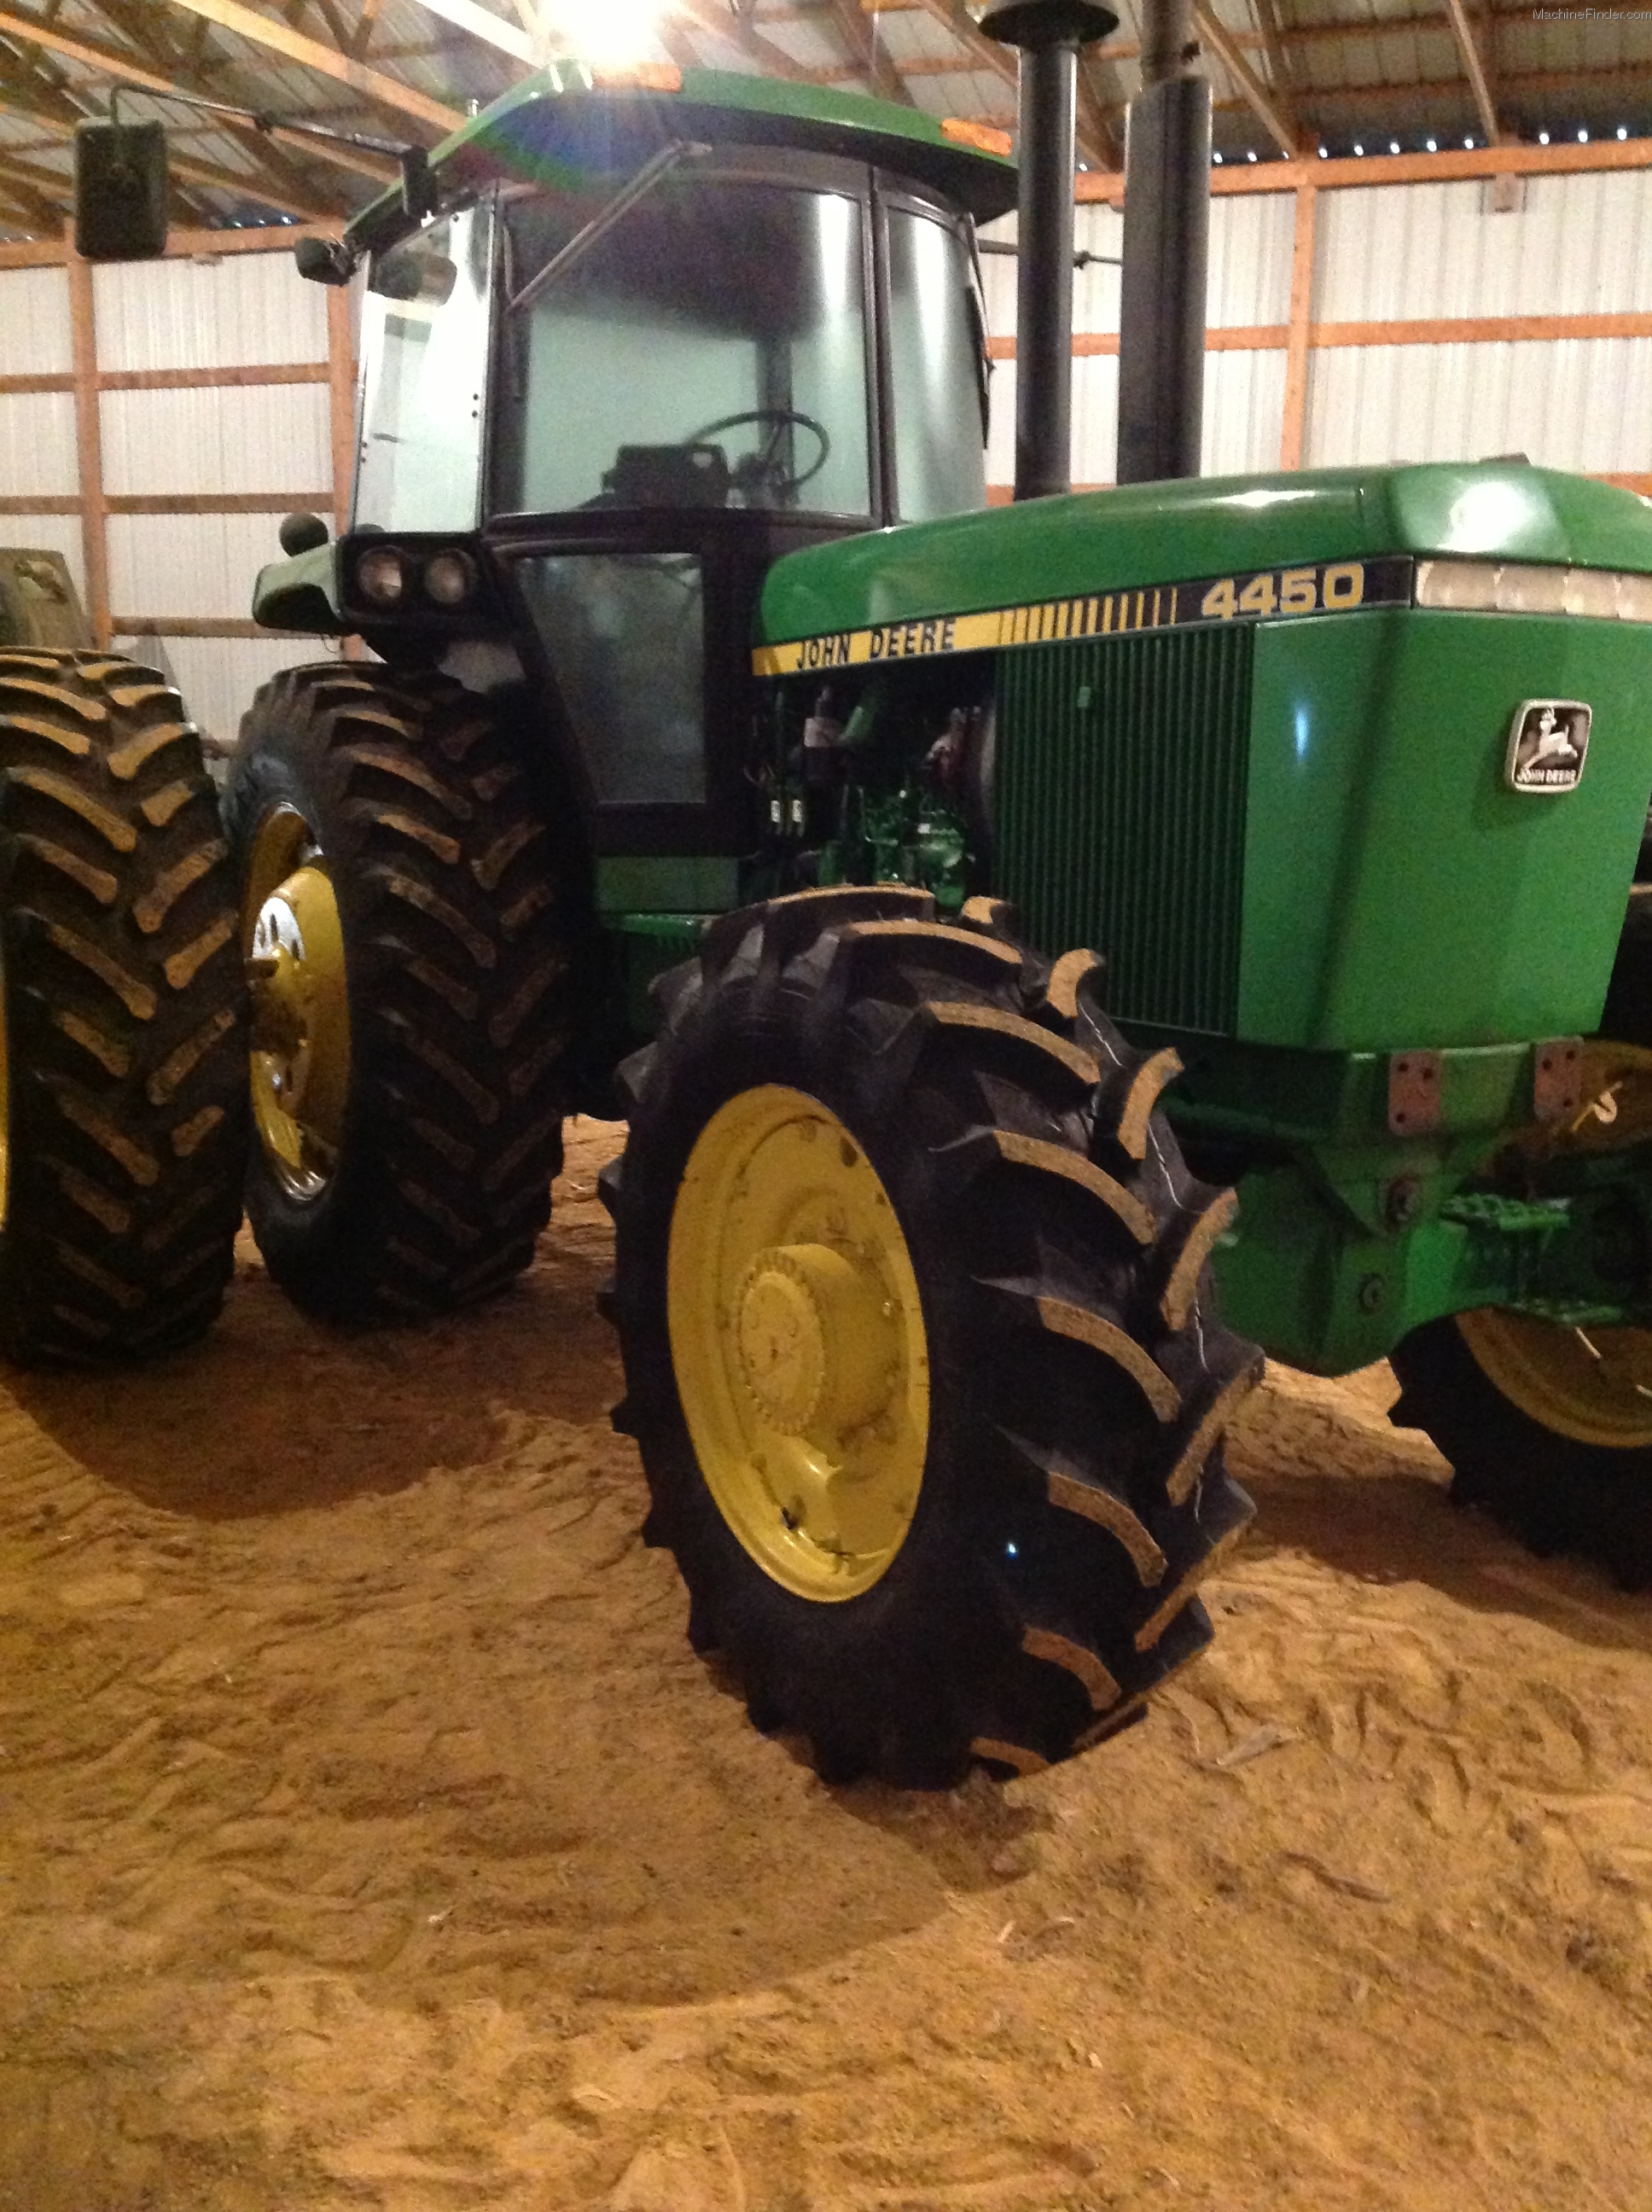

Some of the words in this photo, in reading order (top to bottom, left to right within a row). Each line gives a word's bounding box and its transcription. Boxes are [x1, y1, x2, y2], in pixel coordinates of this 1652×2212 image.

[1201, 563, 1364, 620] 4450
[796, 634, 852, 670] JOHN
[870, 619, 957, 661] DEERE
